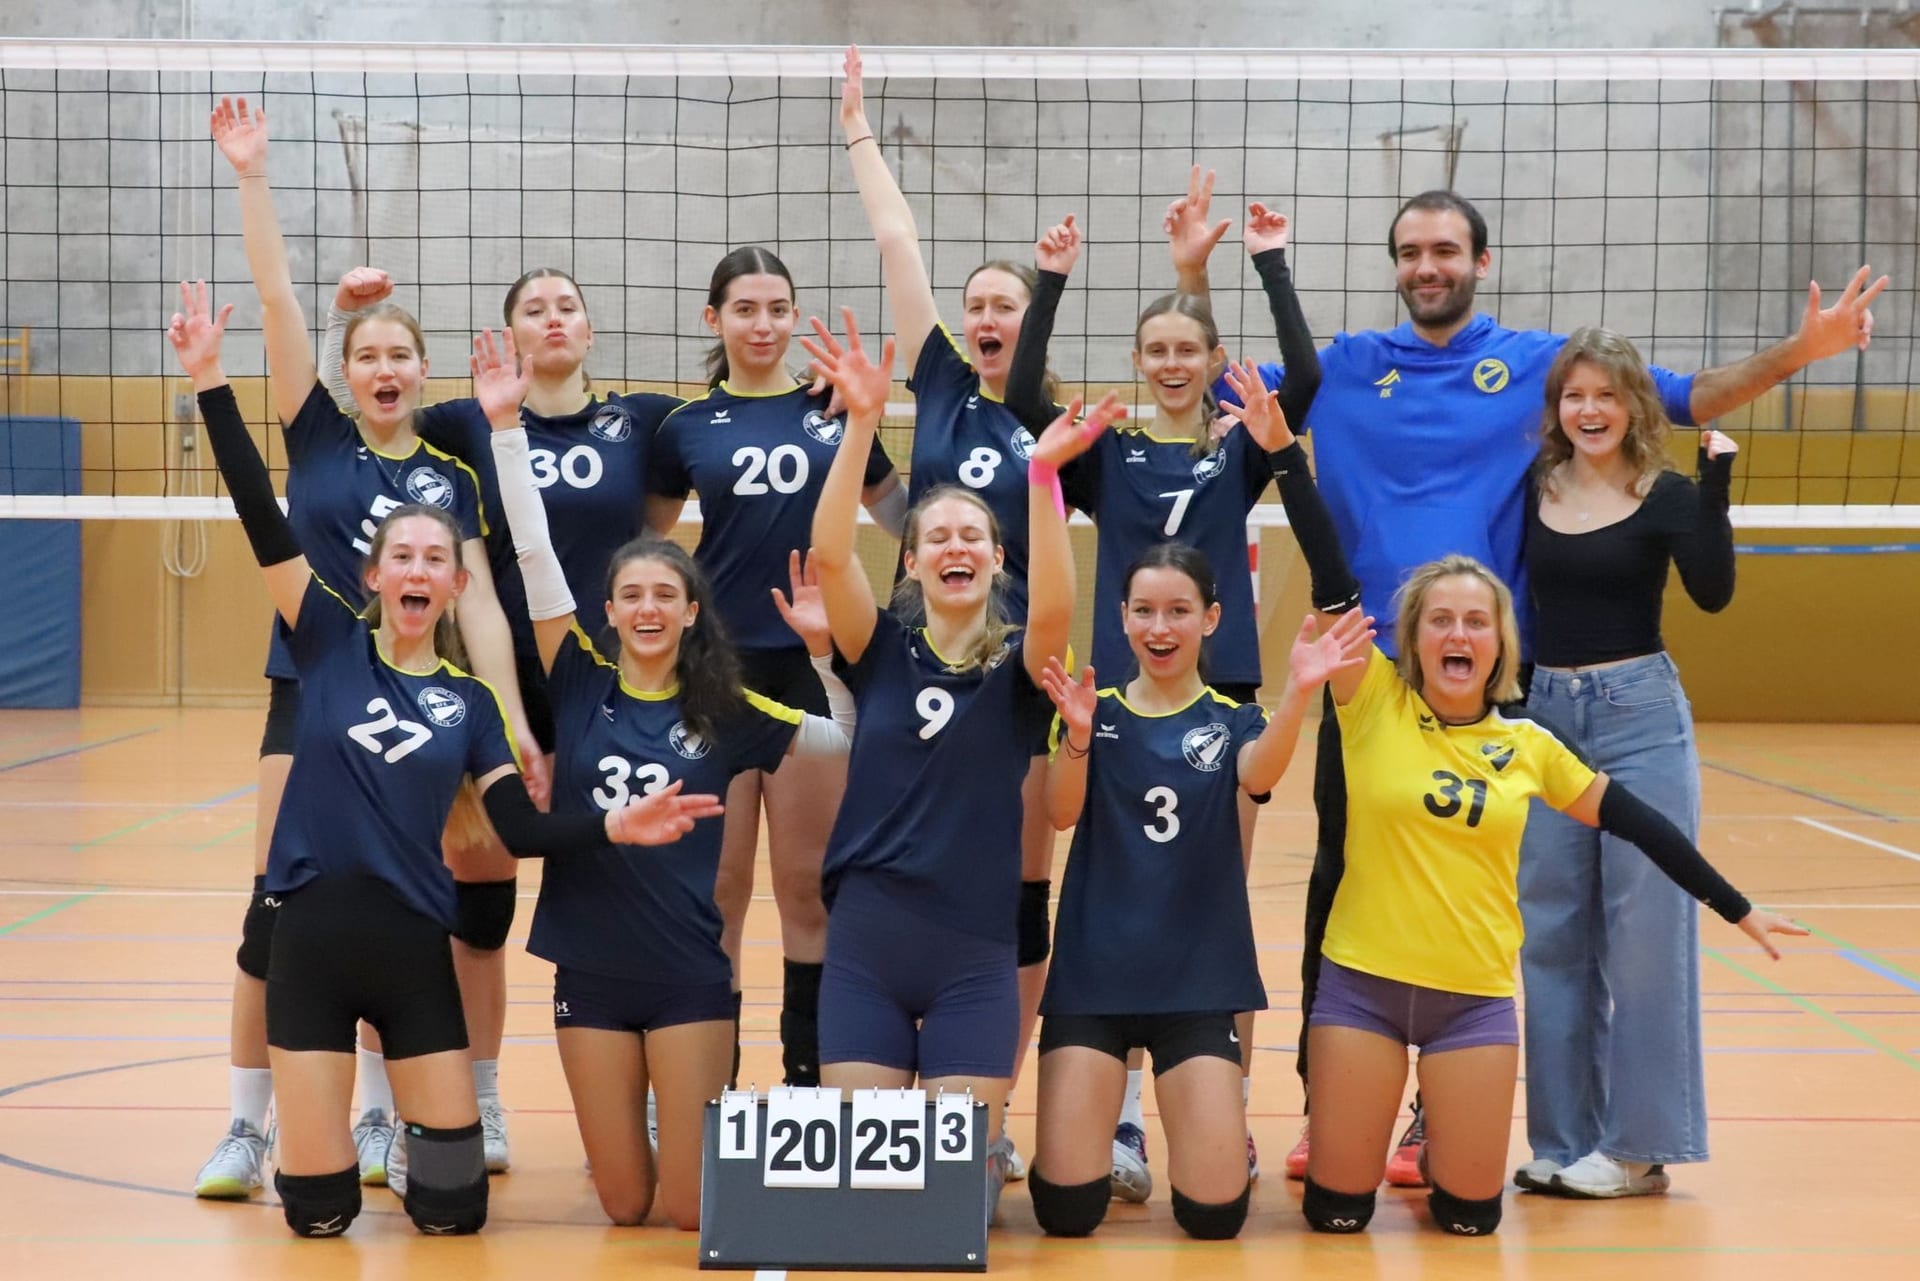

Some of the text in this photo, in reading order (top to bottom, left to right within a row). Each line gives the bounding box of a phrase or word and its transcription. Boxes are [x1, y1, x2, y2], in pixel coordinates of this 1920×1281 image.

[528, 444, 603, 489] 30
[731, 444, 810, 496] 20
[958, 446, 1002, 489] 8
[1158, 489, 1194, 536] 7
[347, 697, 433, 764] 27
[915, 686, 954, 740] 9
[1143, 785, 1180, 843] 3
[1423, 770, 1487, 828] 31
[727, 1110, 967, 1172] 1 20 25 3
